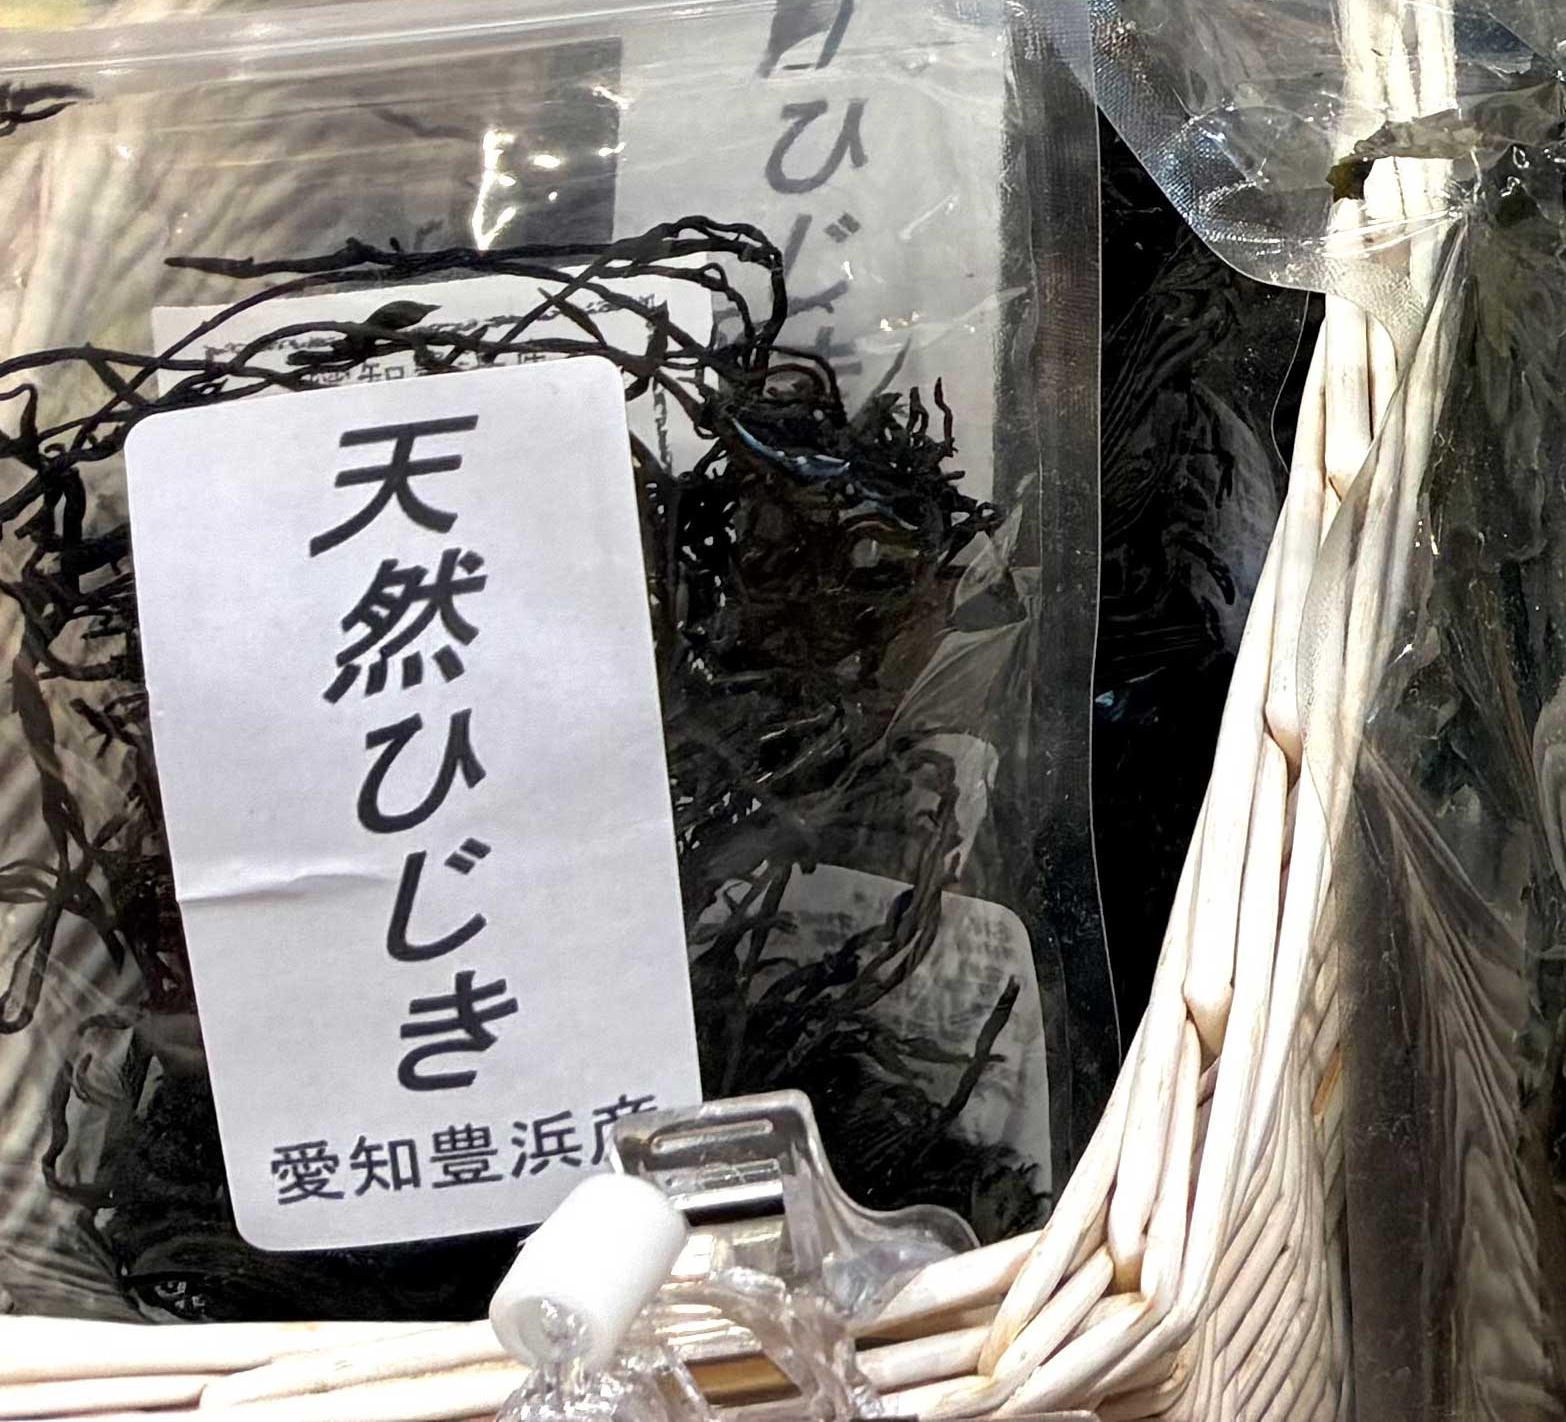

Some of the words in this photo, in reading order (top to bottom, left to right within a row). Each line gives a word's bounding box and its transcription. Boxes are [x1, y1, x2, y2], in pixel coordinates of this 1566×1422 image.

[308, 412, 521, 1094] 天然ひじき
